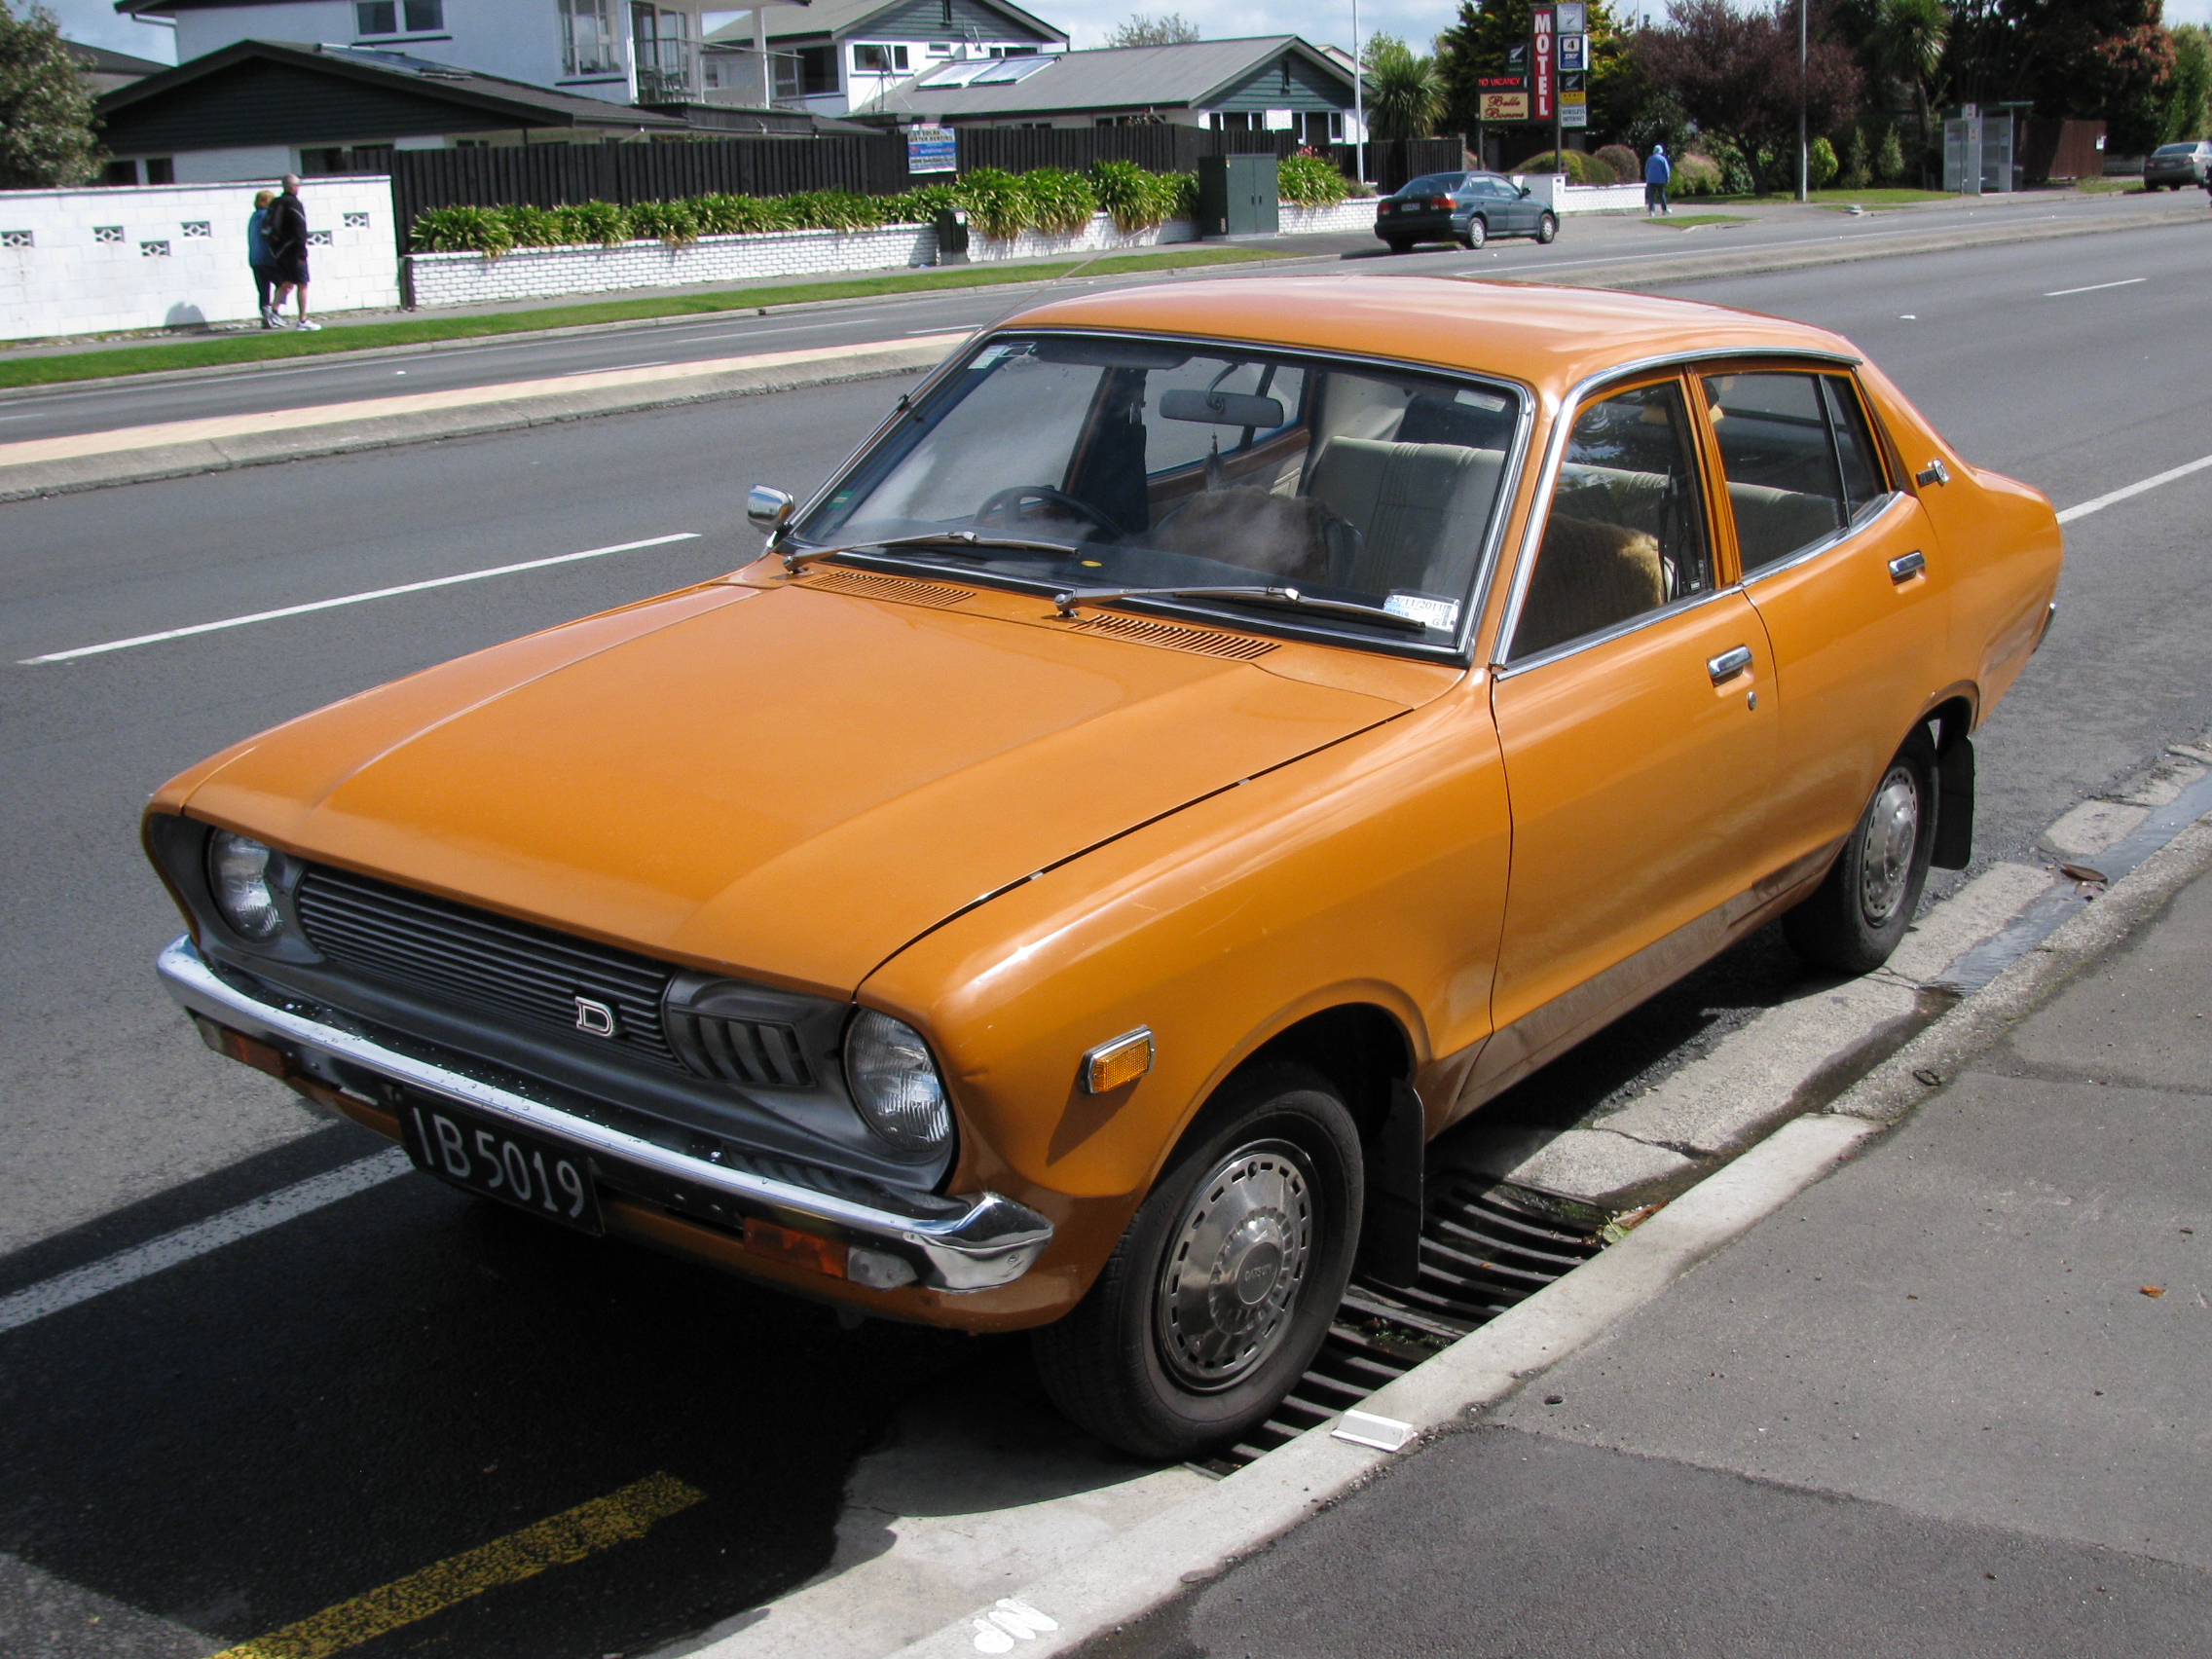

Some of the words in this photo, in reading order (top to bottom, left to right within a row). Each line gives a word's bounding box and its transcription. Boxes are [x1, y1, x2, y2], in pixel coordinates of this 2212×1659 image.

[1567, 40, 1575, 50] 4
[1534, 13, 1552, 116] MOTEL
[1491, 77, 1522, 86] VACANCY
[1387, 595, 1443, 612] 25/11/2011
[574, 996, 614, 1038] D
